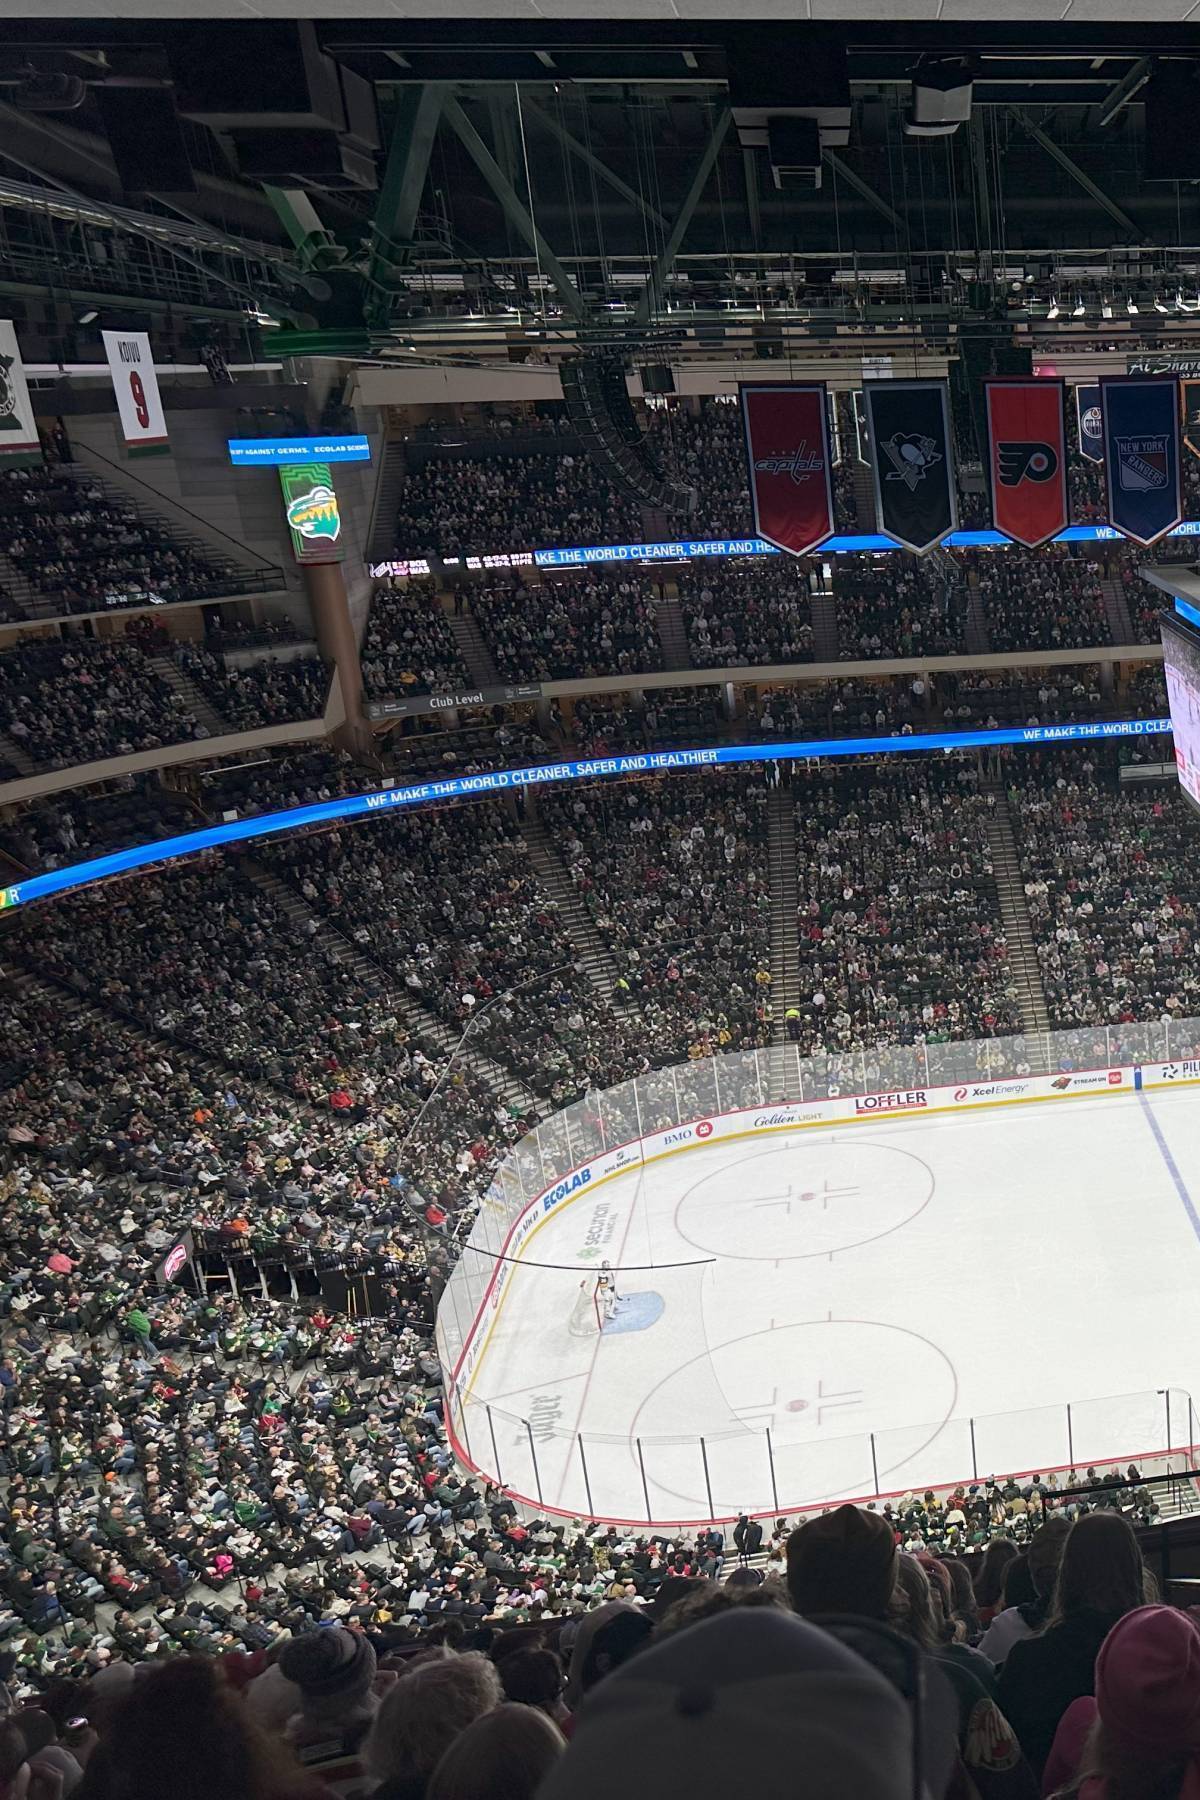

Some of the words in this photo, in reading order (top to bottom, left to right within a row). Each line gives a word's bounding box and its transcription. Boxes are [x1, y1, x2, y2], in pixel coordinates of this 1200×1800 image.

[118, 341, 141, 362] KOIVU
[130, 371, 150, 428] 9
[1121, 443, 1140, 452] NEW
[1141, 440, 1164, 450] YORK
[1127, 455, 1164, 486] RANGERS
[1096, 528, 1112, 538] WE
[558, 550, 580, 563] THE
[584, 548, 627, 560] WORLD
[631, 545, 687, 560] CLEANER,
[690, 542, 724, 555] SAFER
[729, 541, 753, 553] AND
[430, 698, 453, 708] Club
[456, 692, 484, 704] Level
[1024, 730, 1042, 740] WE
[1044, 727, 1076, 738] MAKE
[1080, 726, 1100, 736] THE
[1103, 722, 1144, 734] WORLD
[1146, 720, 1173, 732] CLEA
[366, 795, 387, 807] WE
[391, 786, 428, 802] MAKE
[432, 782, 456, 794] THE
[460, 774, 508, 791] WORLD
[512, 767, 574, 784] CLEANER,
[576, 761, 616, 775] SAFER
[620, 758, 647, 770] AND
[972, 1086, 995, 1096] Xcel
[996, 1084, 1025, 1095] Energy
[855, 1092, 926, 1110] LOFFLER
[754, 1112, 795, 1128] Golden
[798, 1112, 823, 1122] LIGHT
[664, 1130, 692, 1146] BMO
[543, 1168, 592, 1211] ECOLAB
[584, 1202, 611, 1246] securian
